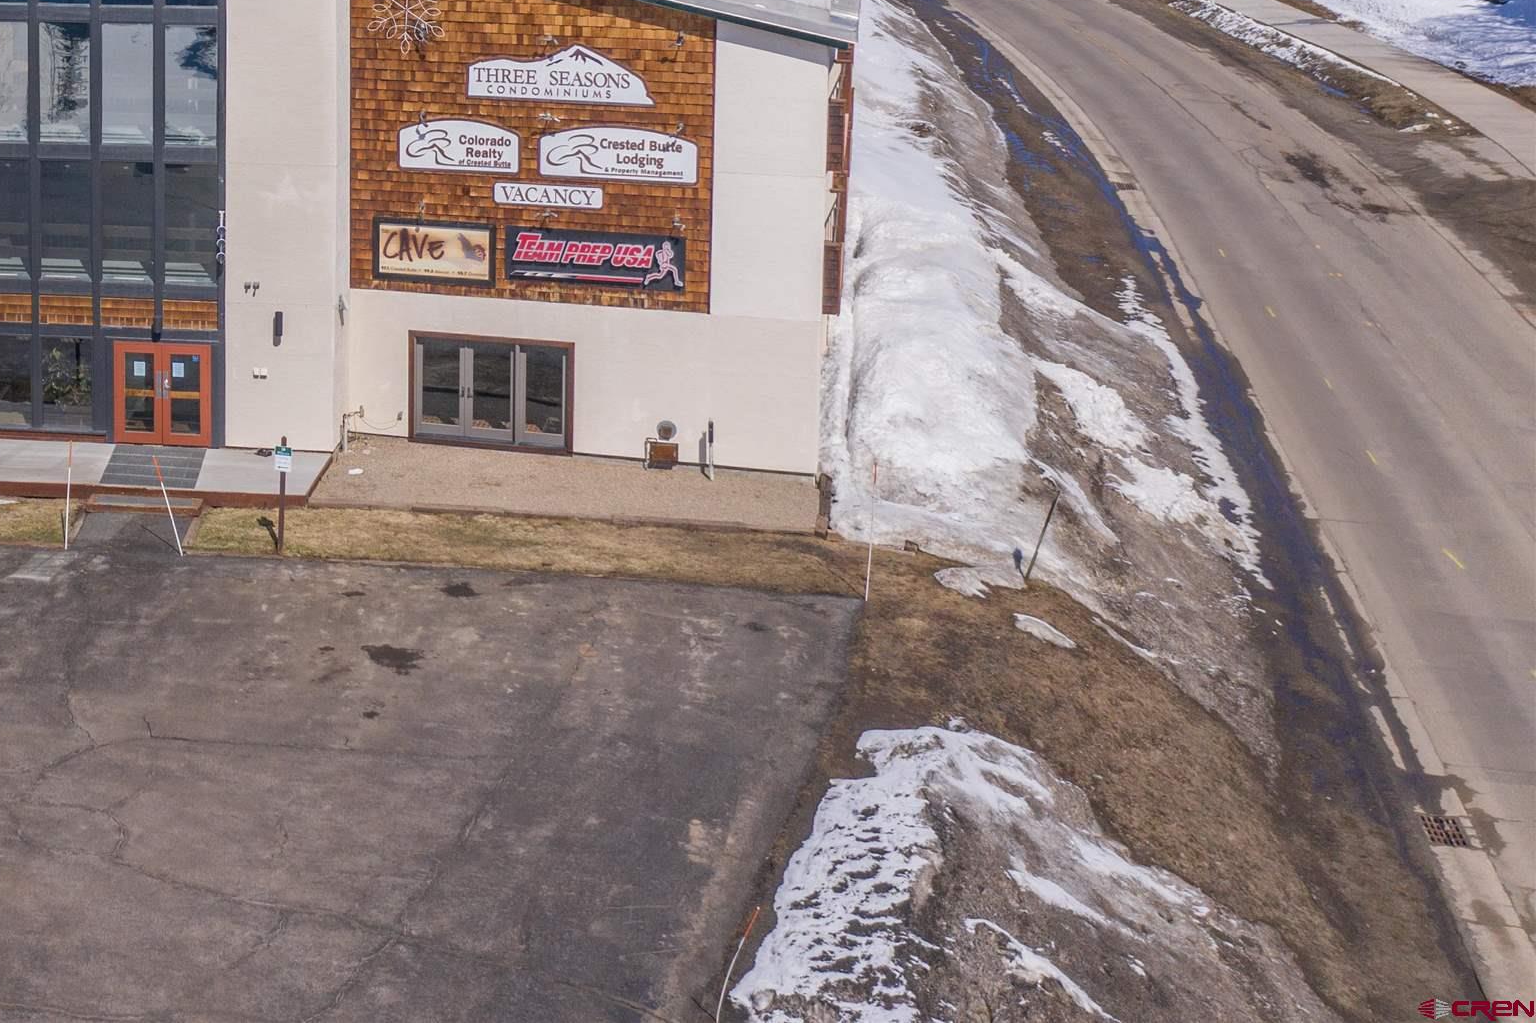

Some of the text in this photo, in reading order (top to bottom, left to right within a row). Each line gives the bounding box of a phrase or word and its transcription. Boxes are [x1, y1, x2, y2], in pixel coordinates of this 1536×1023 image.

[473, 67, 631, 89] THREE SEASONS
[486, 84, 612, 99] CONDOMINIUMS
[458, 134, 512, 147] Colorado
[599, 138, 683, 153] Crested Butte
[465, 147, 504, 161] Realty
[616, 153, 664, 169] Lodging
[611, 167, 639, 175] Property
[640, 168, 684, 177] Management
[500, 185, 596, 206] VACANCY
[383, 227, 445, 262] CAVE
[512, 232, 655, 269] TEAM PREP USA
